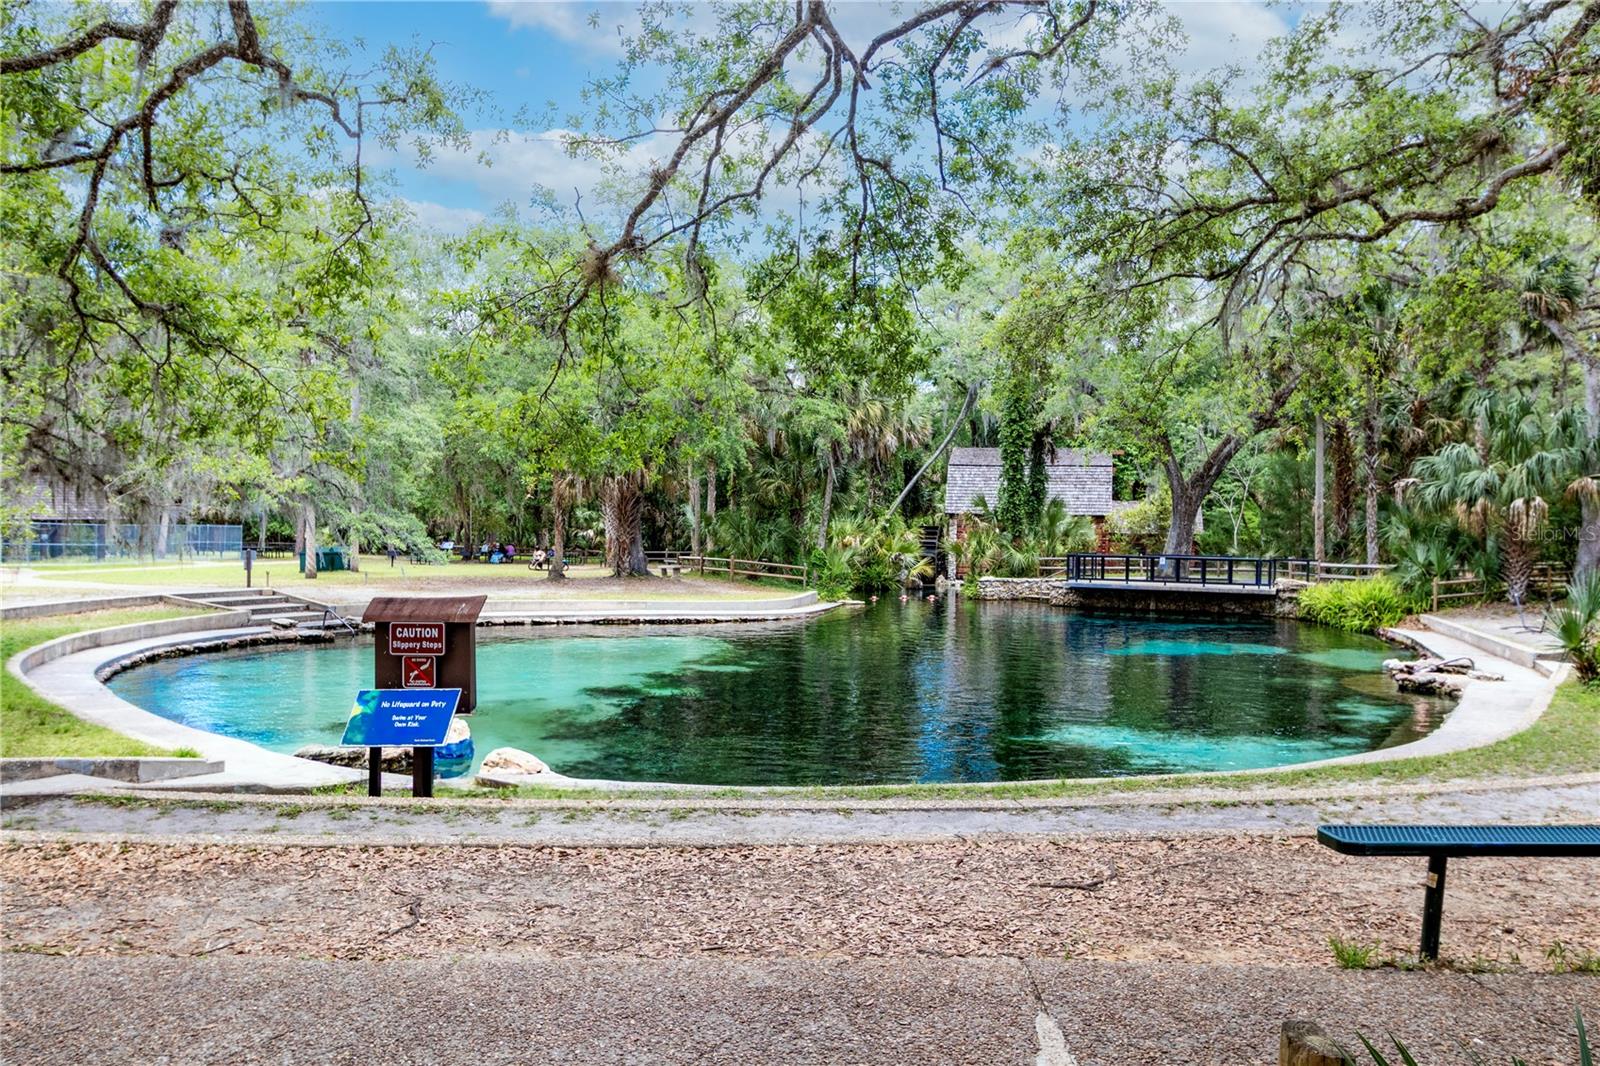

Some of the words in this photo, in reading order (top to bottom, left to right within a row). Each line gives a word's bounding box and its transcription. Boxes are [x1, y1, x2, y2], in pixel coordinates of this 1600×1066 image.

[396, 627, 439, 638] CAUTION
[392, 640, 421, 650] Slippery
[422, 640, 442, 650] Steps
[391, 700, 421, 709] Lifeguard
[430, 700, 447, 709] Duty
